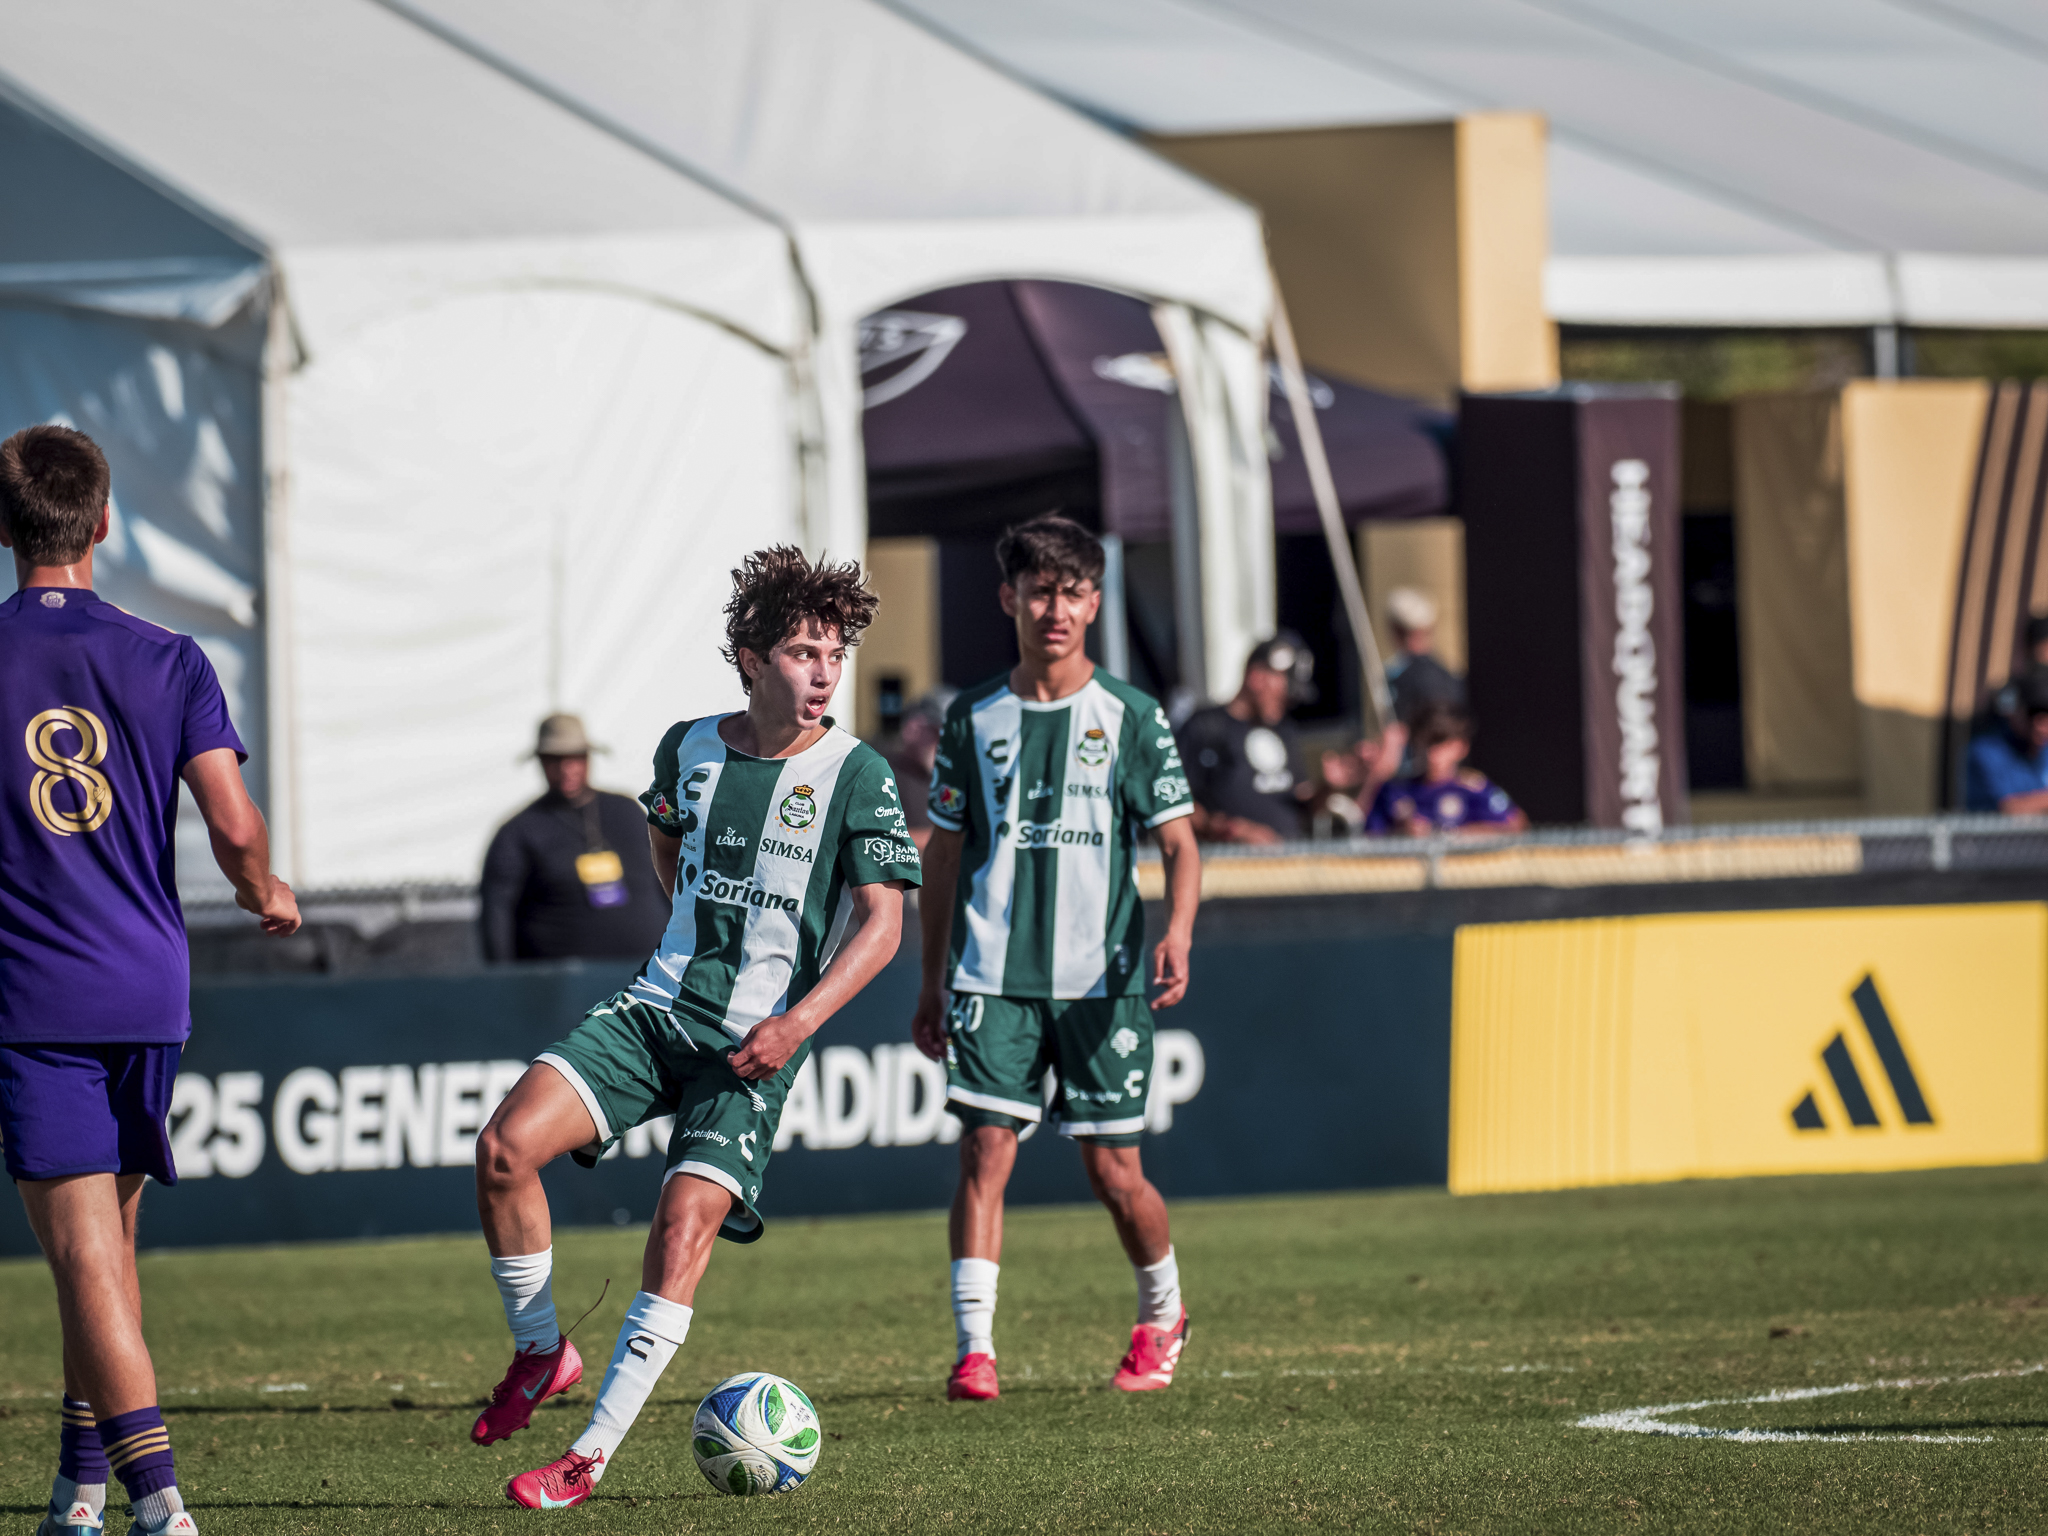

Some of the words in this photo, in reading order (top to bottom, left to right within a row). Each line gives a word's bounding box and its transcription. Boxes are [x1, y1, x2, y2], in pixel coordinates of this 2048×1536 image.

[25, 705, 112, 836] 8
[759, 837, 814, 864] SIMSA
[1017, 823, 1105, 847] Soriana
[699, 874, 800, 913] Soriana
[166, 1071, 267, 1179] 25
[690, 1129, 730, 1147] Totalplay
